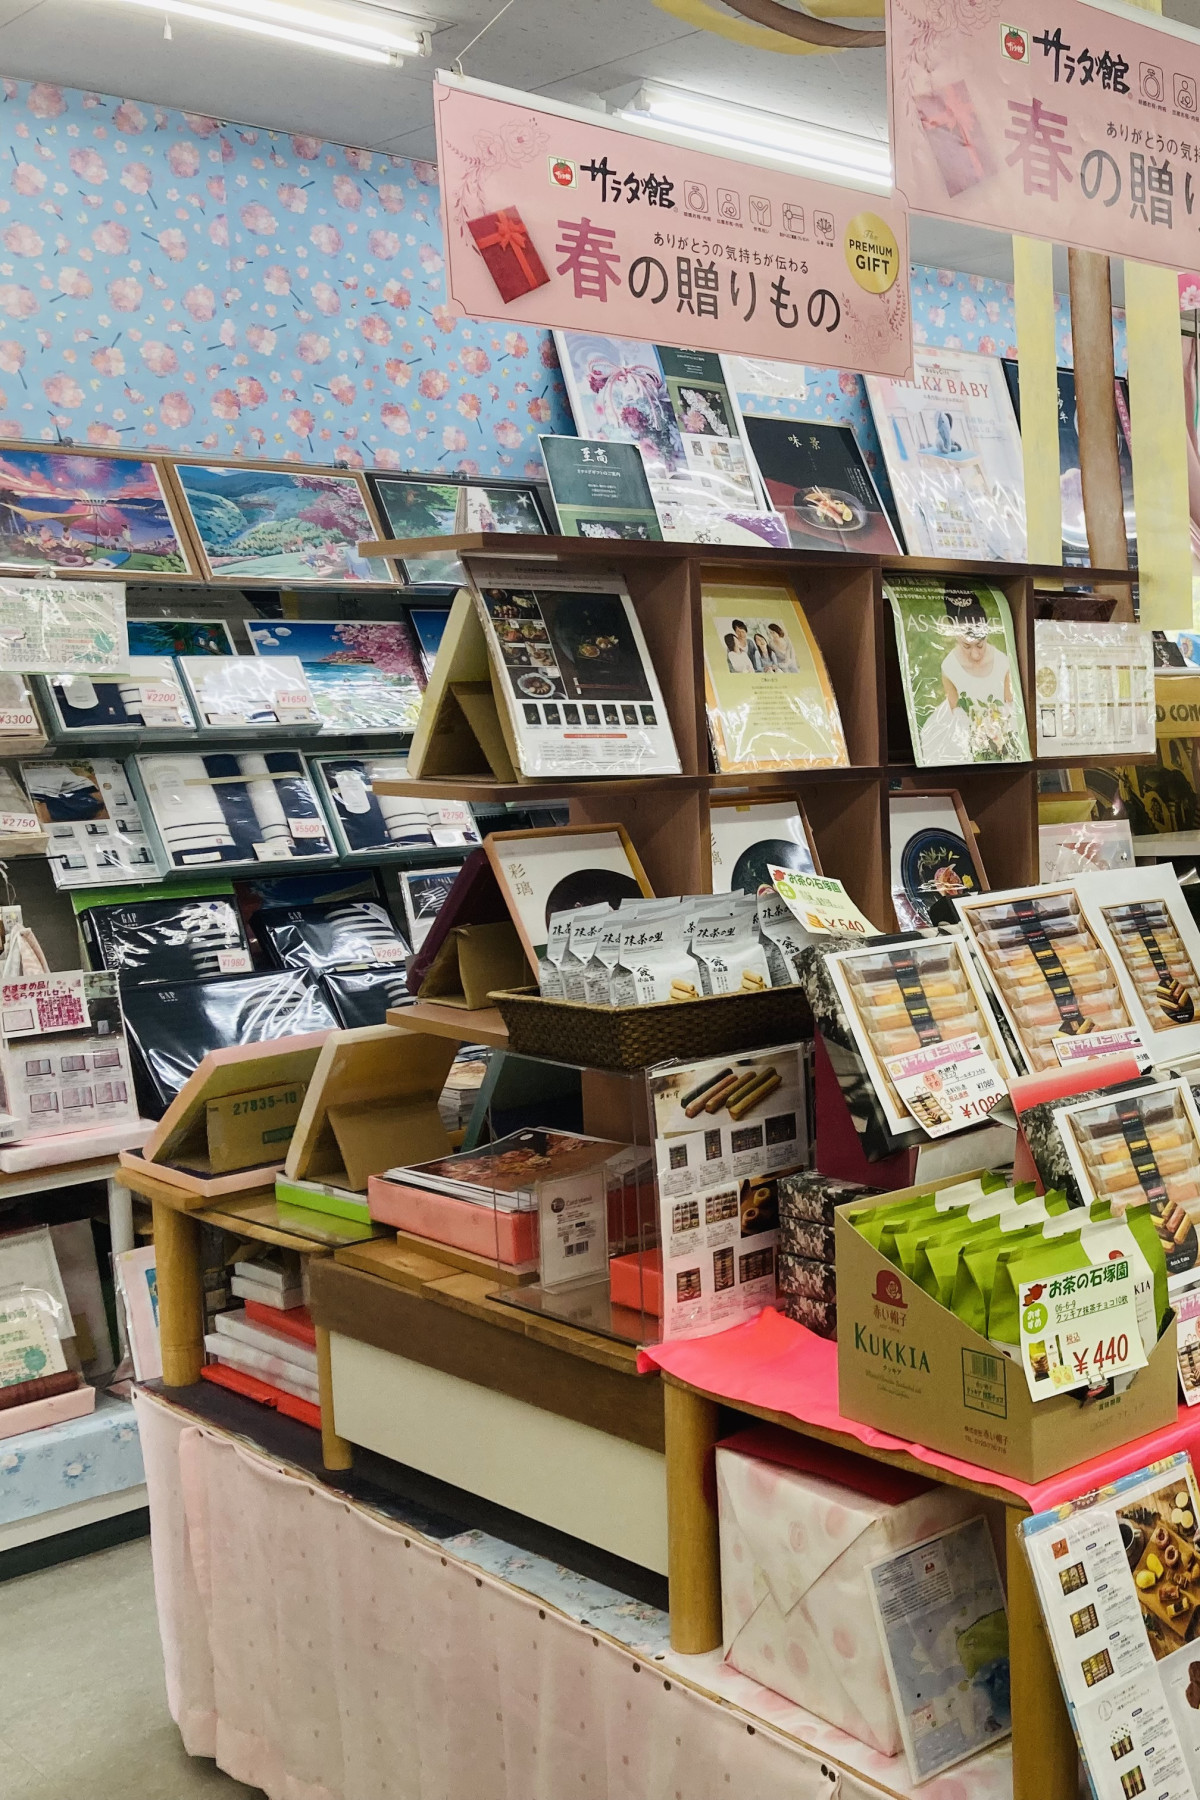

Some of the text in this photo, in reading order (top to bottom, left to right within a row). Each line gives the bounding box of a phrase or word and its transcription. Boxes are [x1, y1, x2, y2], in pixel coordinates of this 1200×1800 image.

[1033, 27, 1130, 94] サラダ館
[579, 156, 676, 210] サラダ館
[653, 232, 809, 274] ありがとうの気持ちが伝わる
[848, 238, 894, 259] PREMIUM
[554, 216, 842, 333] 春の贈りもの
[855, 254, 891, 277] GIFT
[947, 379, 989, 399] BABY
[580, 446, 608, 464] 至高
[907, 614, 929, 633] AS
[146, 691, 176, 702] ¥2200
[280, 694, 307, 705] ¥1650
[0, 714, 33, 725] ¥3300
[2, 817, 37, 830] ¥2750
[294, 823, 321, 835] ¥5500
[787, 873, 843, 894] お茶の石塚園
[121, 913, 137, 923] GAP
[288, 911, 302, 921] GAP
[824, 917, 866, 933] ¥540
[221, 957, 246, 968] ¥1980
[376, 948, 402, 959] ¥2695
[159, 991, 176, 1000] GAP
[1048, 1260, 1129, 1299] お茶の石塚園
[1134, 1279, 1151, 1296] KIA
[873, 1304, 908, 1327] 赤い帽子
[854, 1322, 931, 1373] KUKKIA
[1072, 1333, 1129, 1375] ¥440
